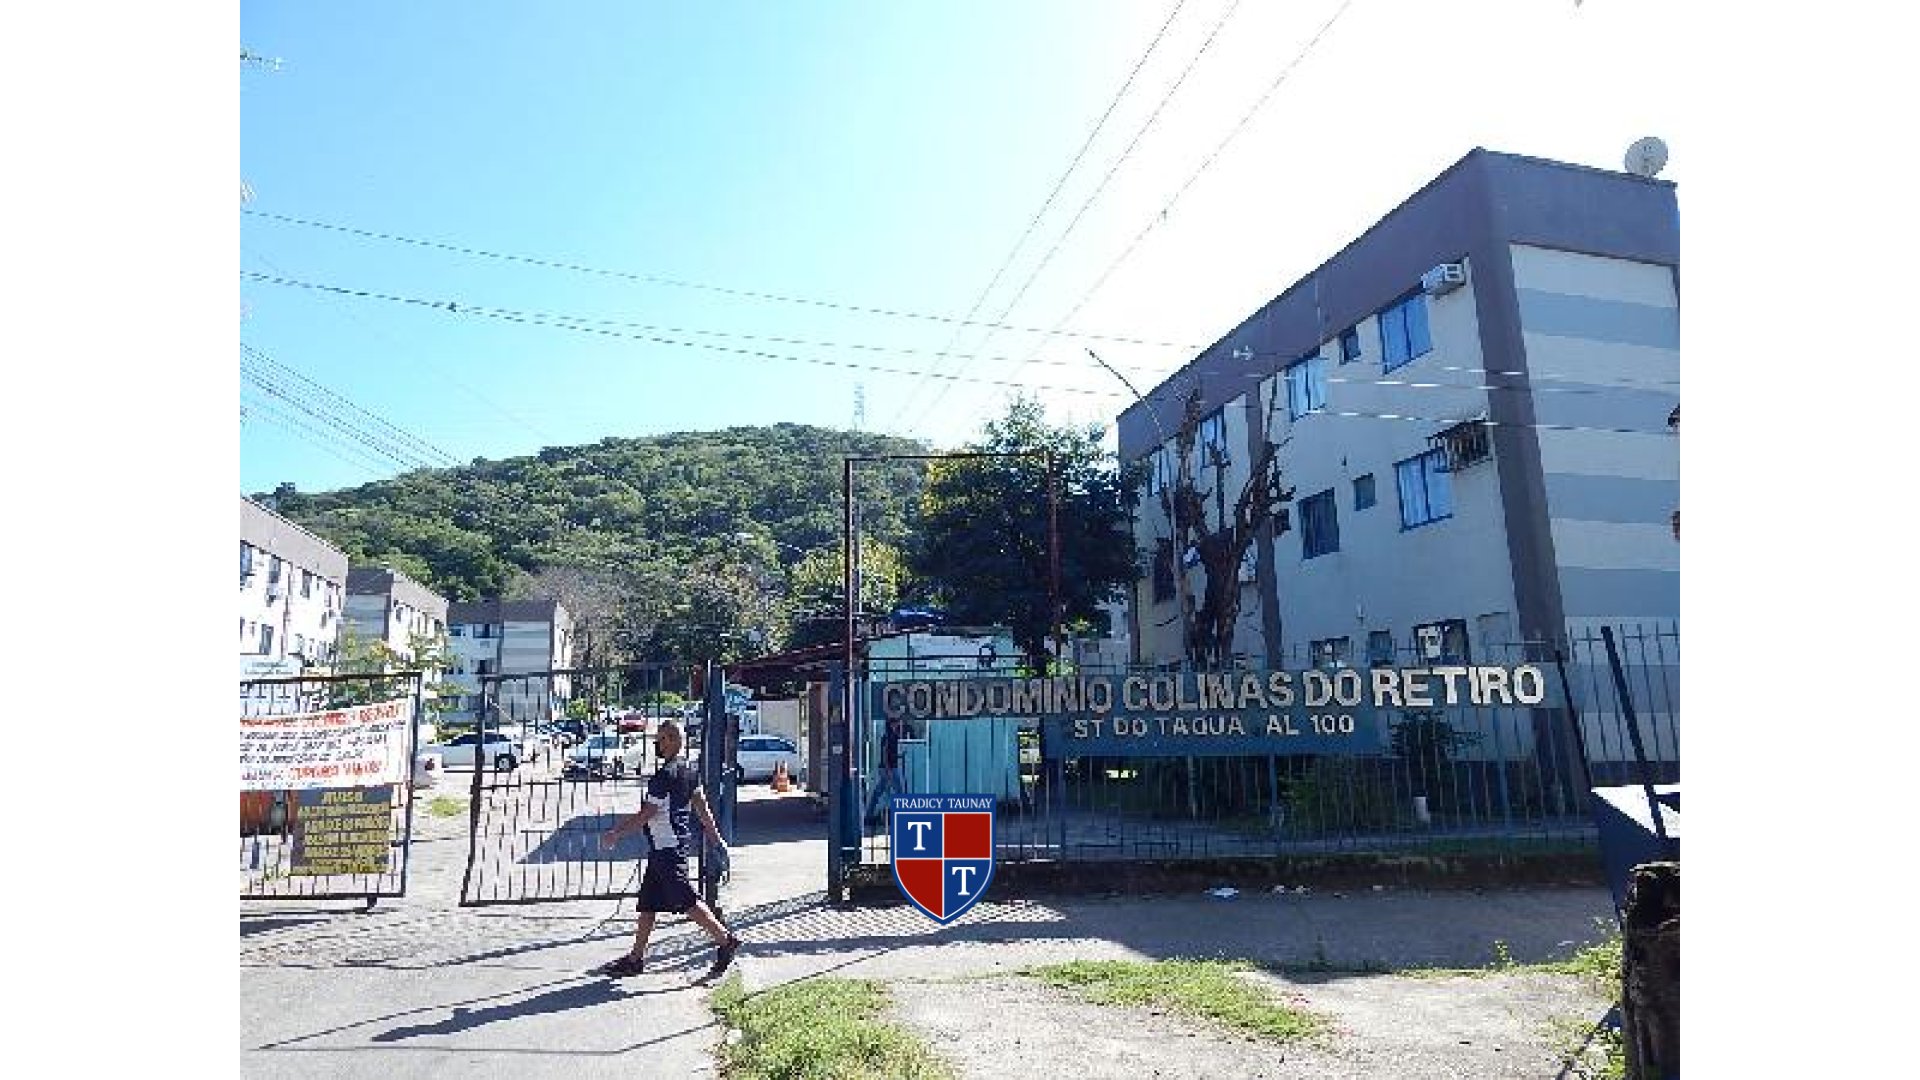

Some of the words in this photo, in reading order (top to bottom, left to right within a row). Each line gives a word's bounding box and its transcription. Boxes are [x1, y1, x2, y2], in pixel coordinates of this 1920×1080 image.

[1123, 672, 1296, 710] COLINAS
[1304, 670, 1362, 707] DO
[1371, 665, 1545, 706] RETIRO
[1073, 719, 1104, 738] ST
[1113, 718, 1149, 736] DO
[1266, 715, 1299, 736] AL
[1309, 715, 1355, 734] 100
